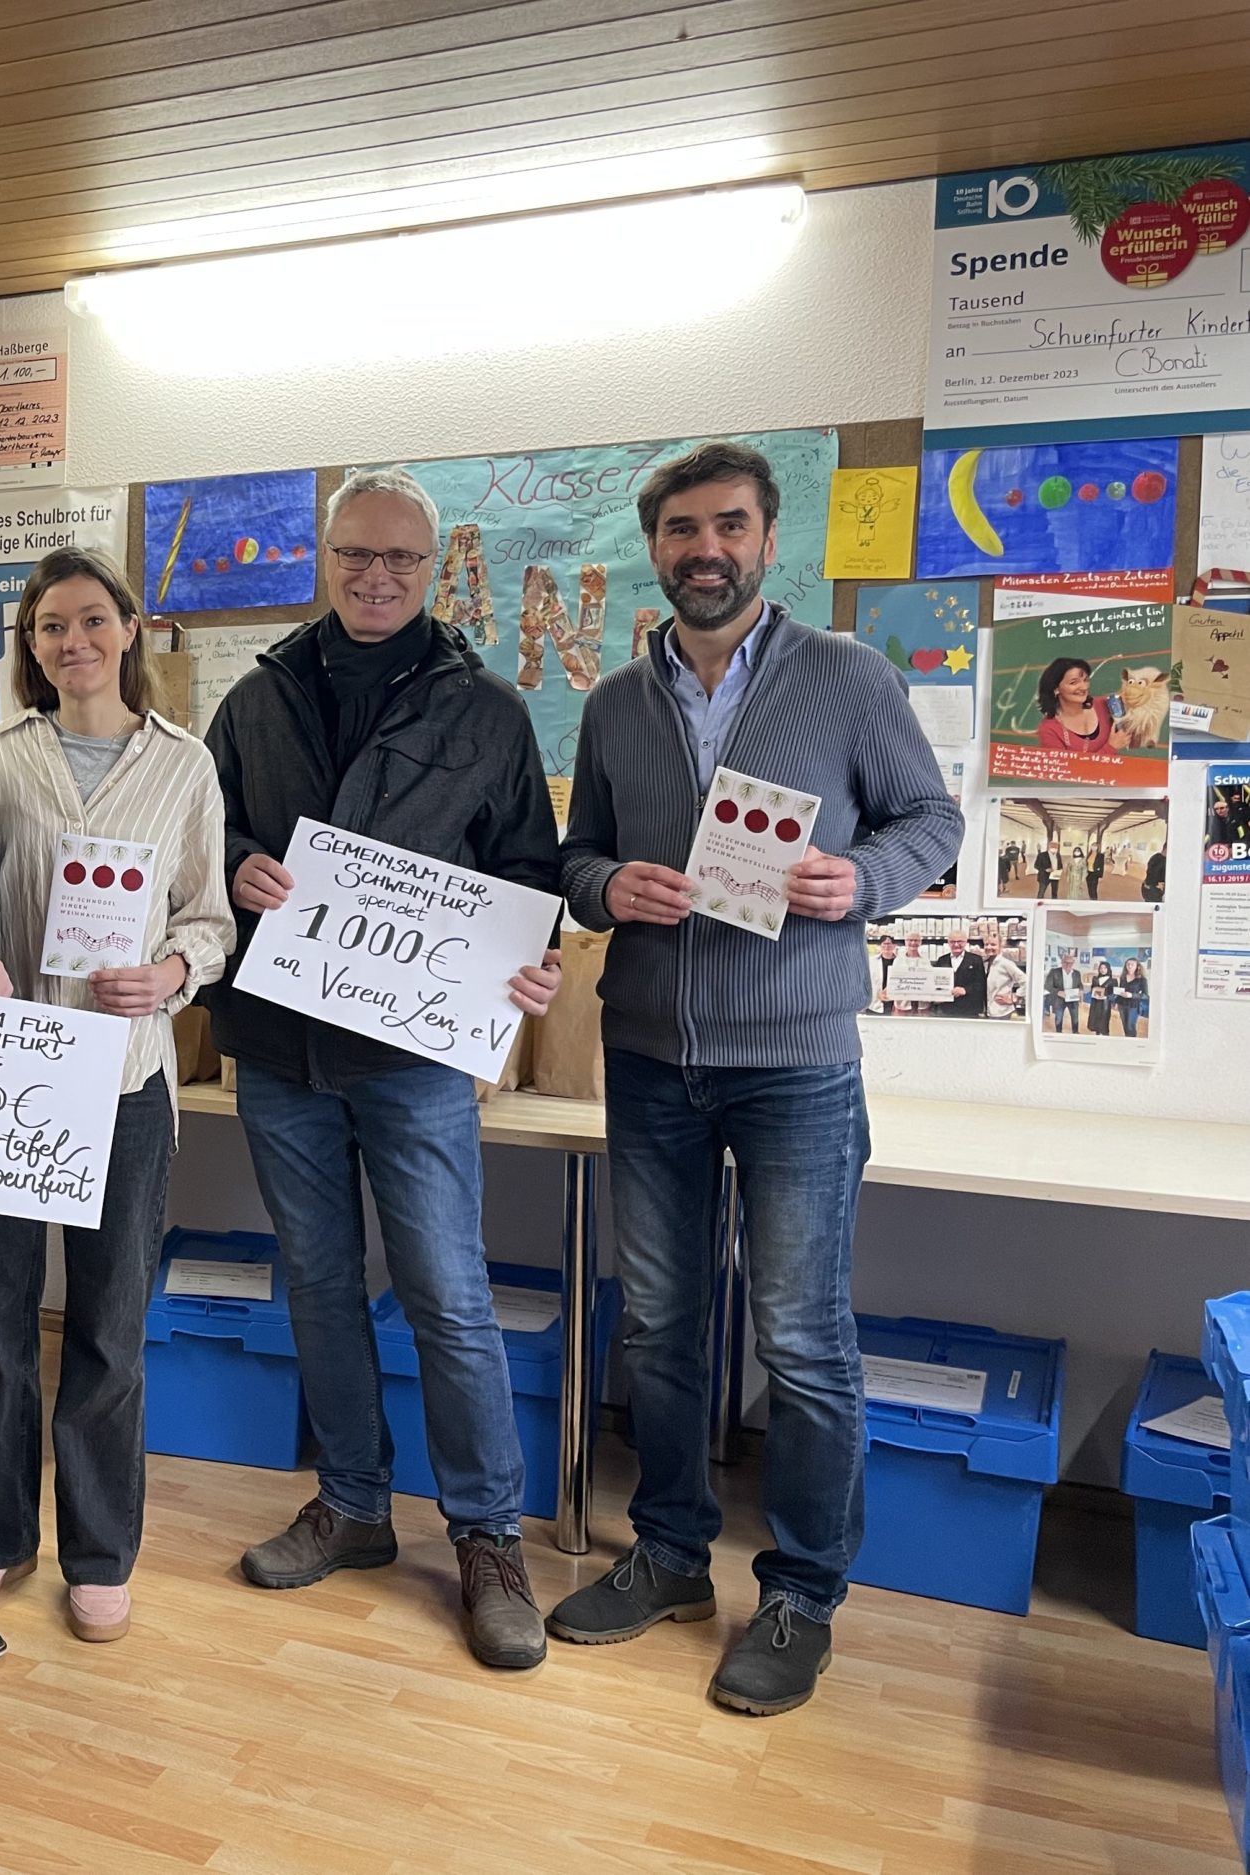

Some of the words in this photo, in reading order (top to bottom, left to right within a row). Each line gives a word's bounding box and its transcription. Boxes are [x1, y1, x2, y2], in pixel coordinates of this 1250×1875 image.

[1183, 199, 1238, 214] Wunsch
[1117, 224, 1181, 242] Wunsch
[1110, 238, 1187, 256] erfüllerin
[950, 244, 1069, 280] Spende
[949, 291, 1024, 311] Tausend
[948, 322, 970, 330] Betrag
[981, 318, 1021, 327] Buchstaben
[946, 346, 966, 358] an
[945, 378, 977, 388] Berlin,
[981, 376, 996, 384] 12.
[1000, 372, 1050, 383] Dezember
[1053, 370, 1079, 379] 2023
[1114, 386, 1159, 394] Unterschrift
[1176, 381, 1216, 390] Ausstellers
[474, 456, 621, 510] Klasse
[626, 448, 664, 492] 7
[16, 507, 85, 526] Schulbrot
[90, 505, 112, 521] für
[25, 531, 76, 548] Kinder!
[490, 521, 595, 564] salamat
[1002, 575, 1060, 586] Mitmachen
[1063, 572, 1120, 583] Zuschauen
[1124, 571, 1168, 580] Zuhören
[1043, 618, 1057, 628] Da
[1092, 612, 1104, 623] du
[1107, 607, 1142, 620] einfach
[1146, 605, 1165, 615] hin!
[1188, 614, 1223, 626] Guten
[1047, 629, 1057, 639] In
[1059, 627, 1074, 637] die
[1077, 623, 1114, 635] Schule,
[1116, 621, 1144, 632] fertig,
[709, 832, 722, 840] DIE
[707, 839, 735, 852] SINGEN
[309, 830, 440, 883] GEMEINSAM
[446, 875, 493, 906] FÜR
[705, 846, 786, 875] WEIHNACHTSLIEDER
[334, 862, 487, 918] SCHWEINFURT
[61, 902, 88, 910] SINGEN
[77, 897, 115, 906] SCHNÜDEL
[355, 893, 428, 922] spendet
[60, 910, 136, 922] WEIHNACHTSLIEDER
[294, 903, 469, 984] 1.000€
[273, 956, 301, 978] an
[321, 961, 398, 1013] Verein
[20, 1014, 76, 1045] FÜR
